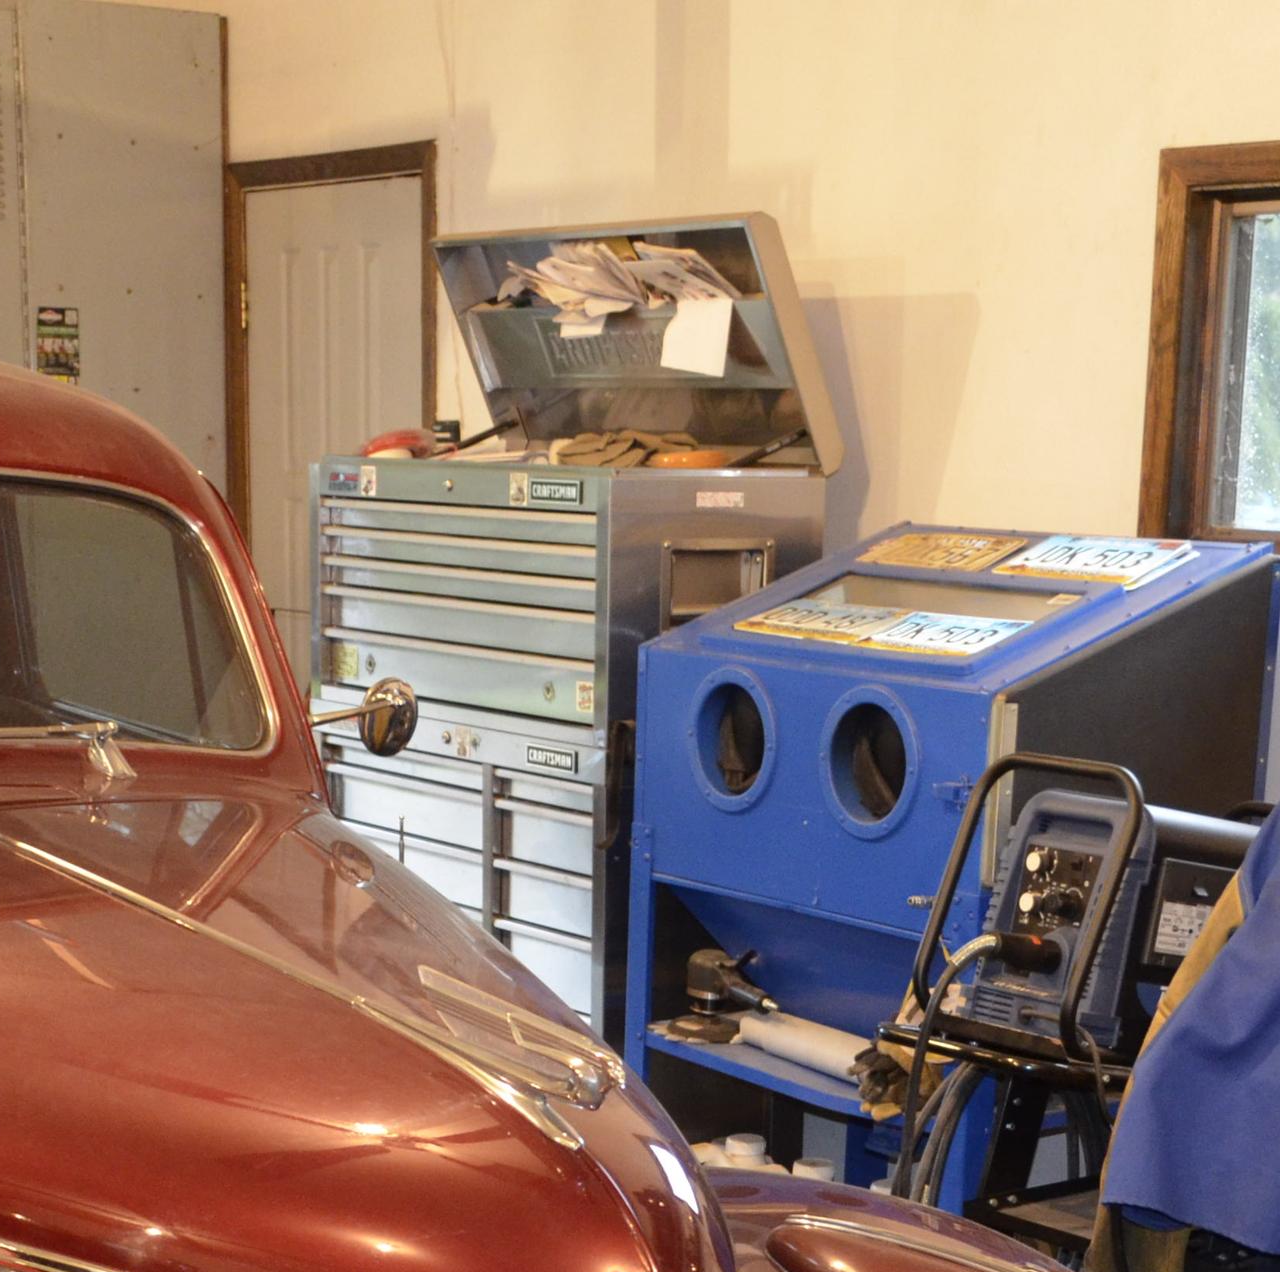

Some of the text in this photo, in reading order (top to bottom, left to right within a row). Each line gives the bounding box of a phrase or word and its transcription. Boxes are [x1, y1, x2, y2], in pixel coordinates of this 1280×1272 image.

[531, 482, 577, 500] CRAFTSMAN
[1024, 545, 1153, 569] JDK 503
[928, 626, 999, 645] 503
[528, 748, 572, 768] CRAFTSMAN
